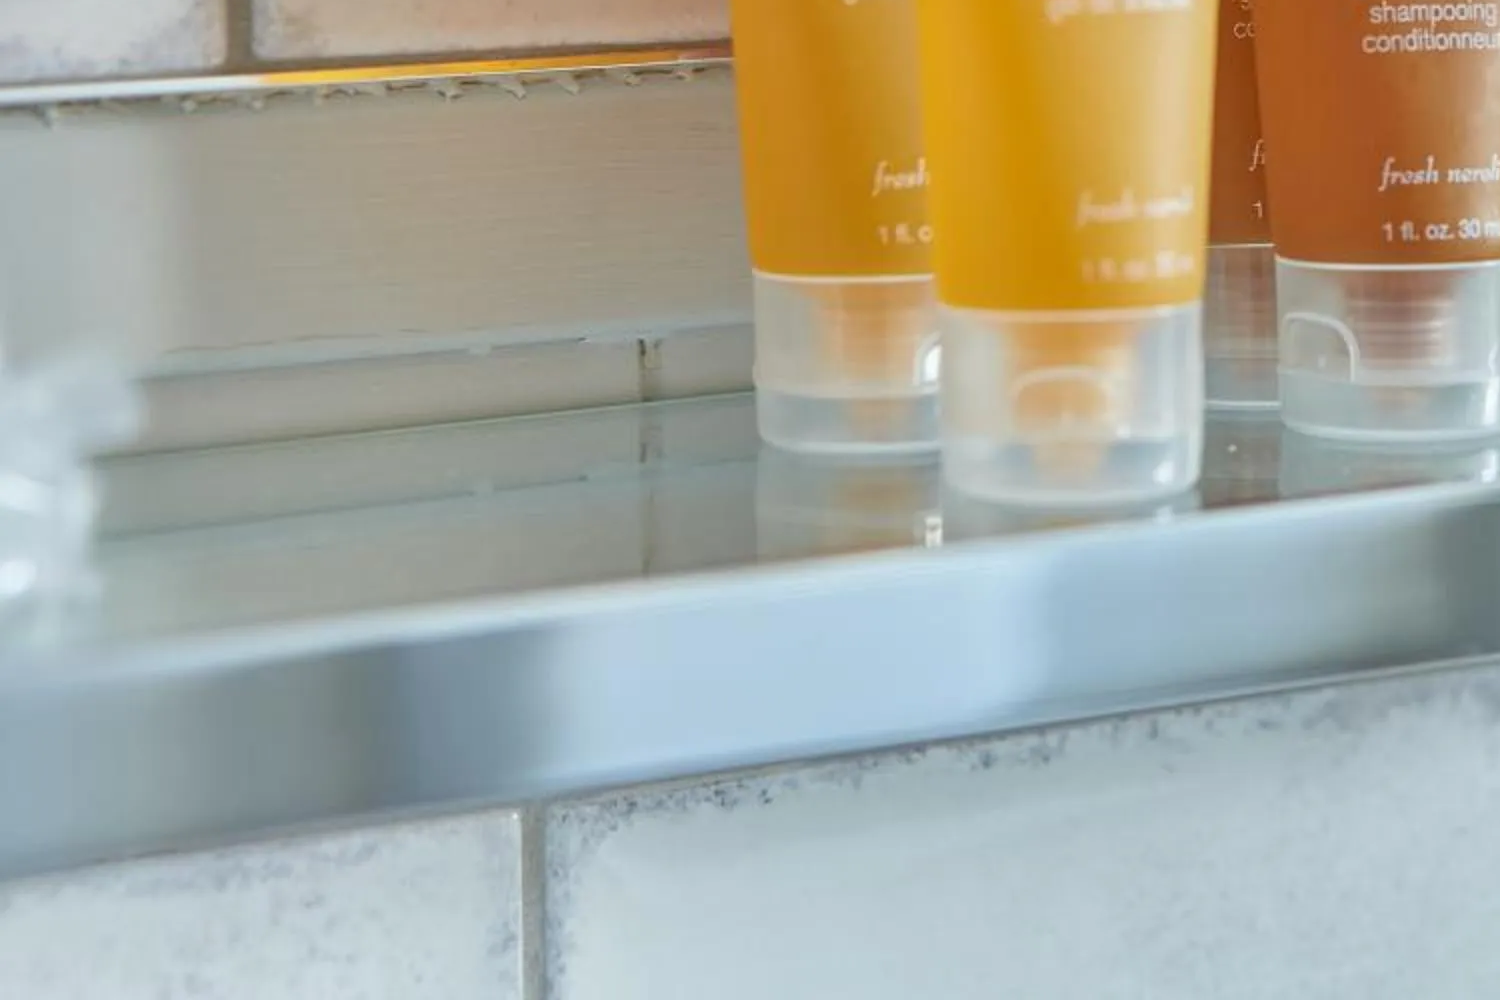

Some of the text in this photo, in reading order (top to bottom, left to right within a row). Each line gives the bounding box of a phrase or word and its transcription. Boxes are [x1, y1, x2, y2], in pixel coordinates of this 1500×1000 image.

[1369, 0, 1498, 28] shampooing
[1378, 154, 1439, 192] fresh
[1382, 221, 1393, 241] 1
[1458, 218, 1480, 239] 30
